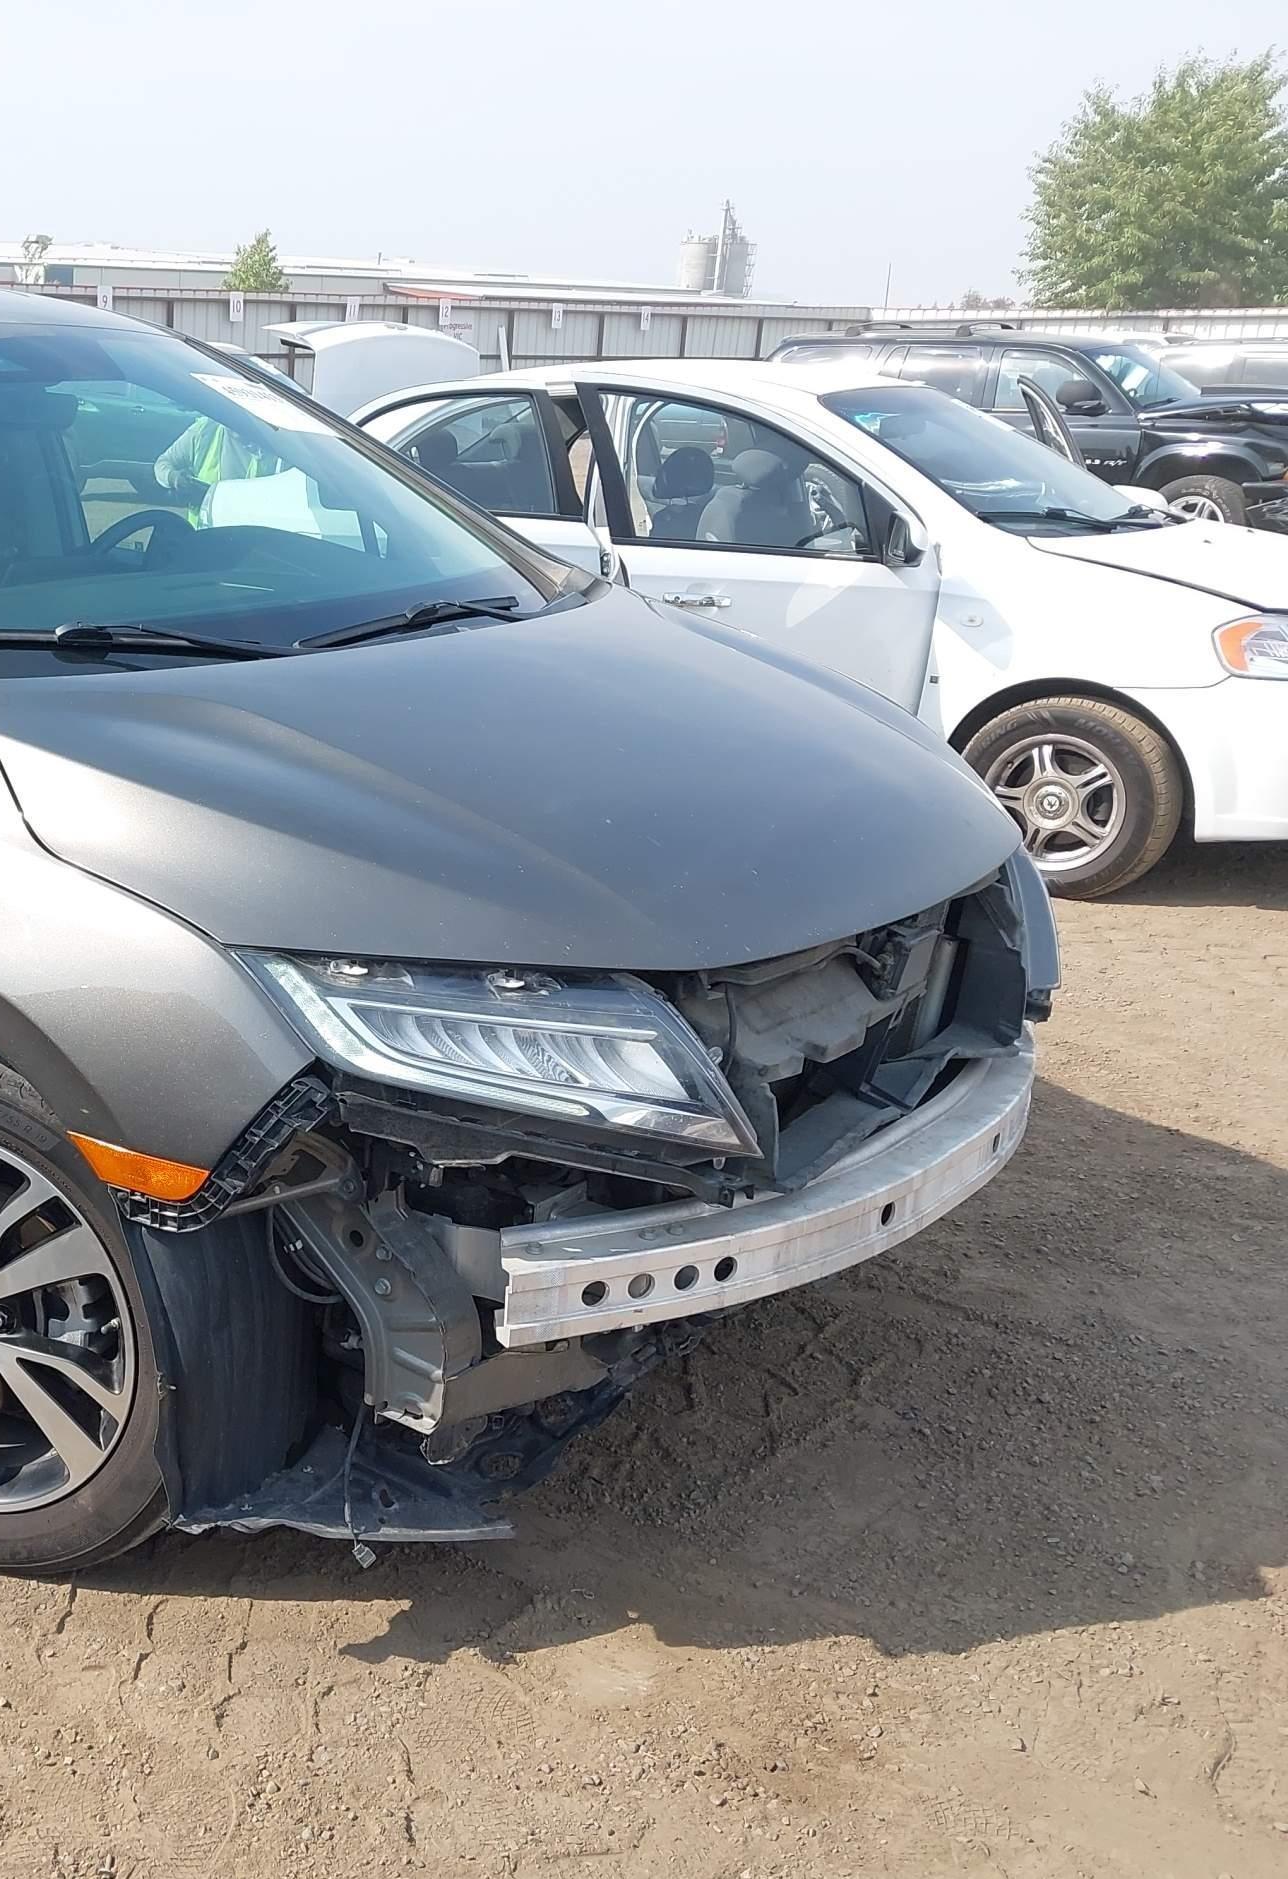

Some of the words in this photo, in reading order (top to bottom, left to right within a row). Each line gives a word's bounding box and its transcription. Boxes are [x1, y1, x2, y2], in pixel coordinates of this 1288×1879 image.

[102, 295, 108, 308] 9
[232, 300, 242, 313] 10
[441, 306, 450, 318] 12
